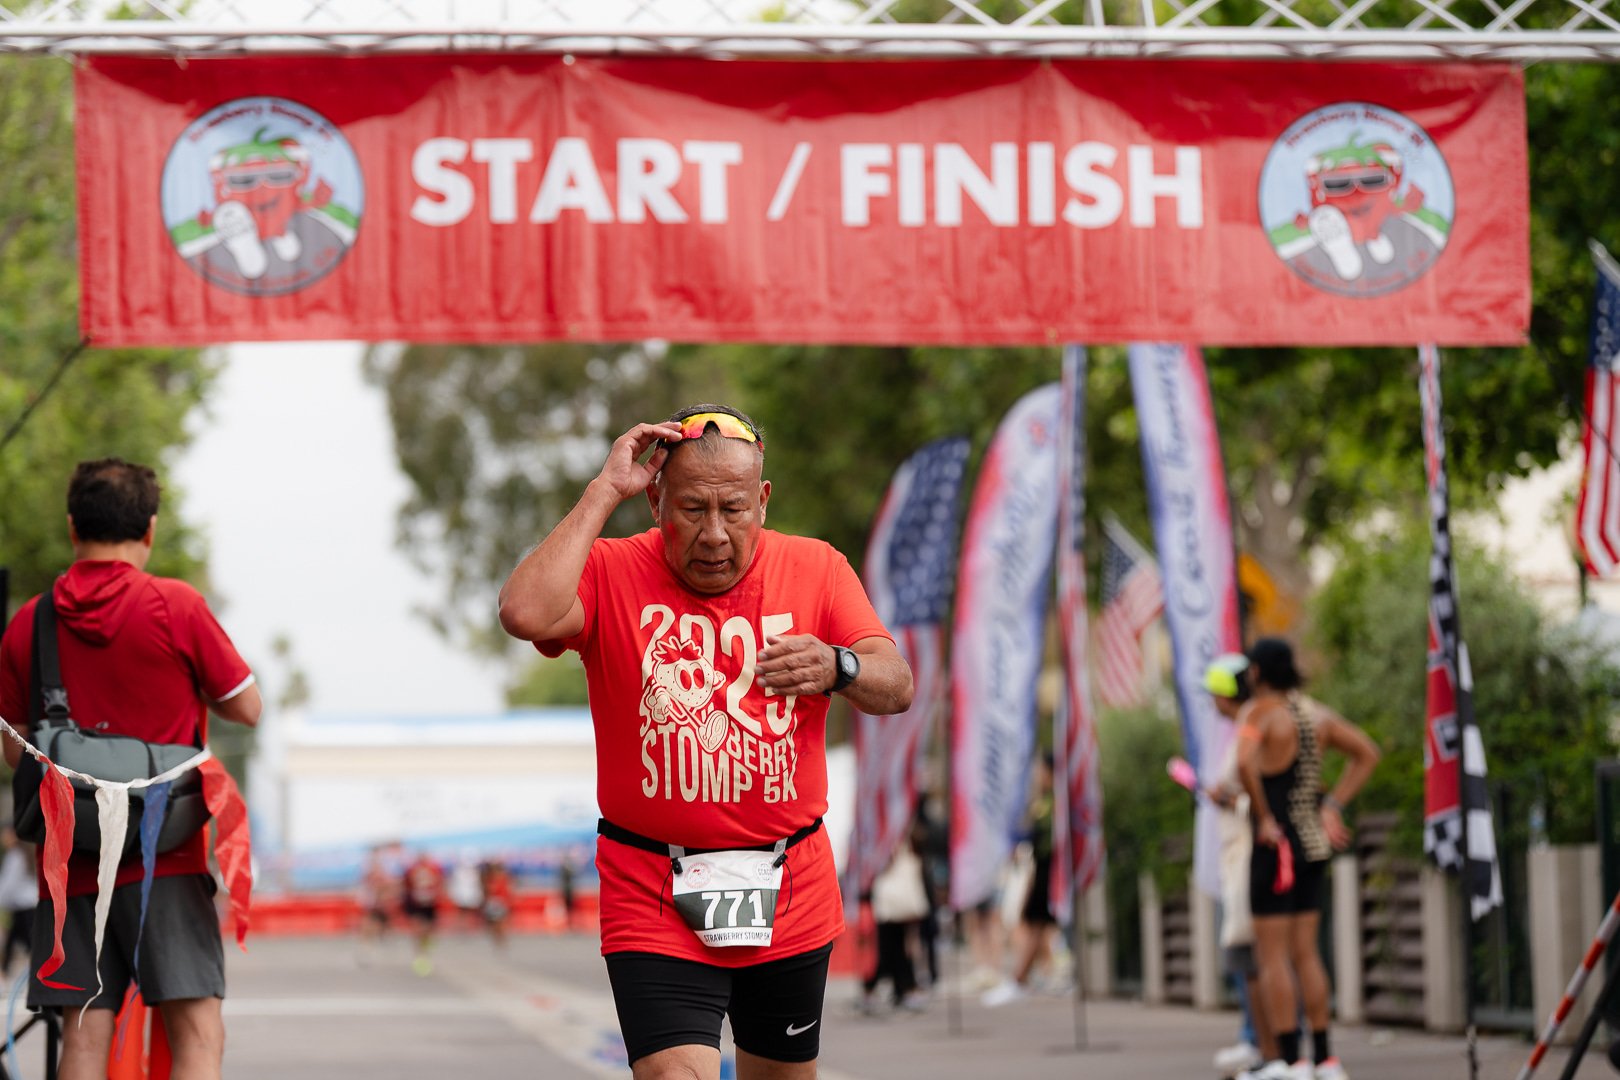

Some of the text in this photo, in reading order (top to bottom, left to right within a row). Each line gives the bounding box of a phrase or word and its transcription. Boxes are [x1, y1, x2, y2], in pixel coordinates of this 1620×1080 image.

[411, 138, 1204, 229] START / FINISH
[641, 722, 752, 803] STOMP
[763, 753, 798, 804] 5K
[701, 889, 767, 930] 771
